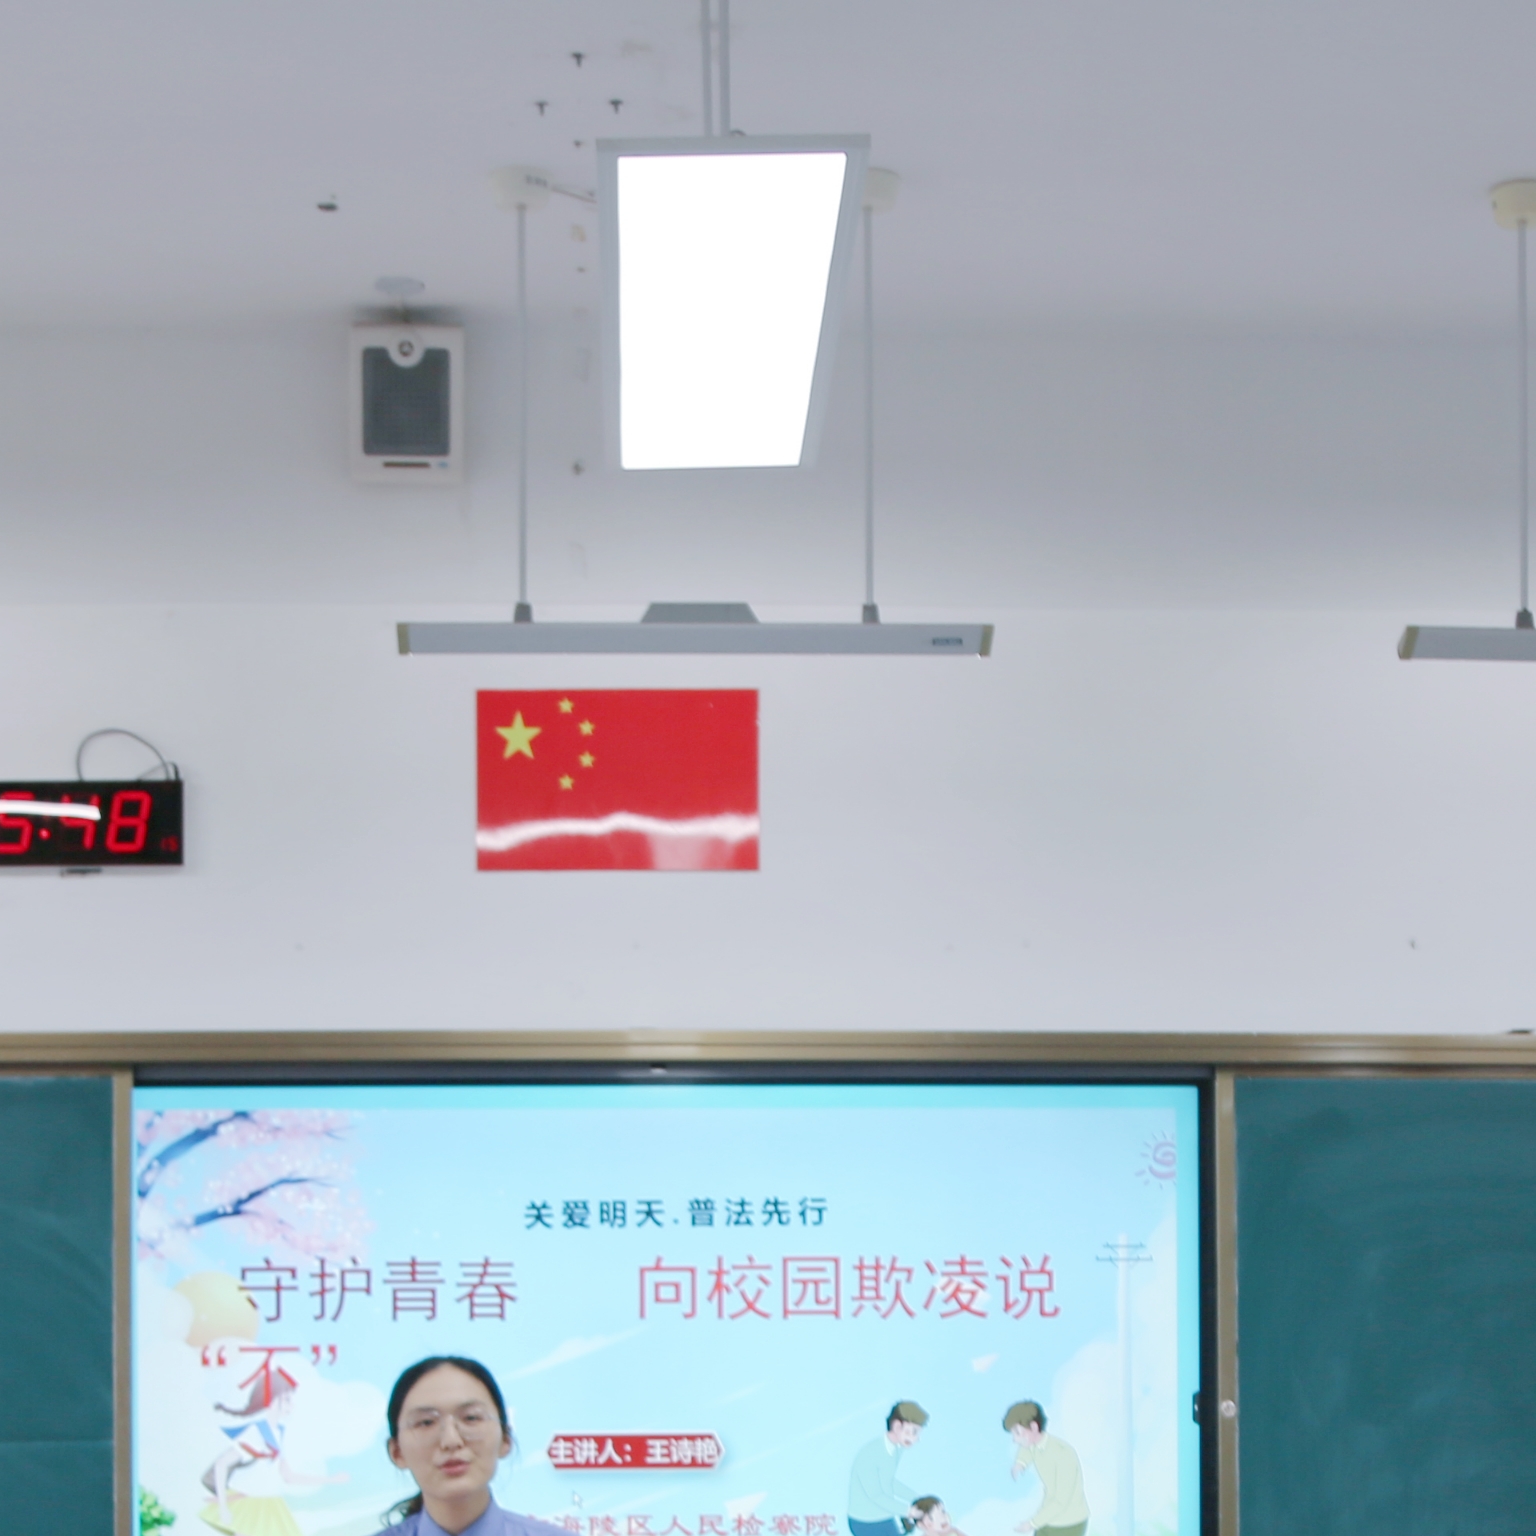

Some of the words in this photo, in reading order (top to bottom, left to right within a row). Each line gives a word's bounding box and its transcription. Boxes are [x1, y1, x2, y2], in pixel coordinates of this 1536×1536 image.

[238, 1256, 517, 1323] 守护青春
[638, 1254, 1061, 1320] 向校园欺凌说
